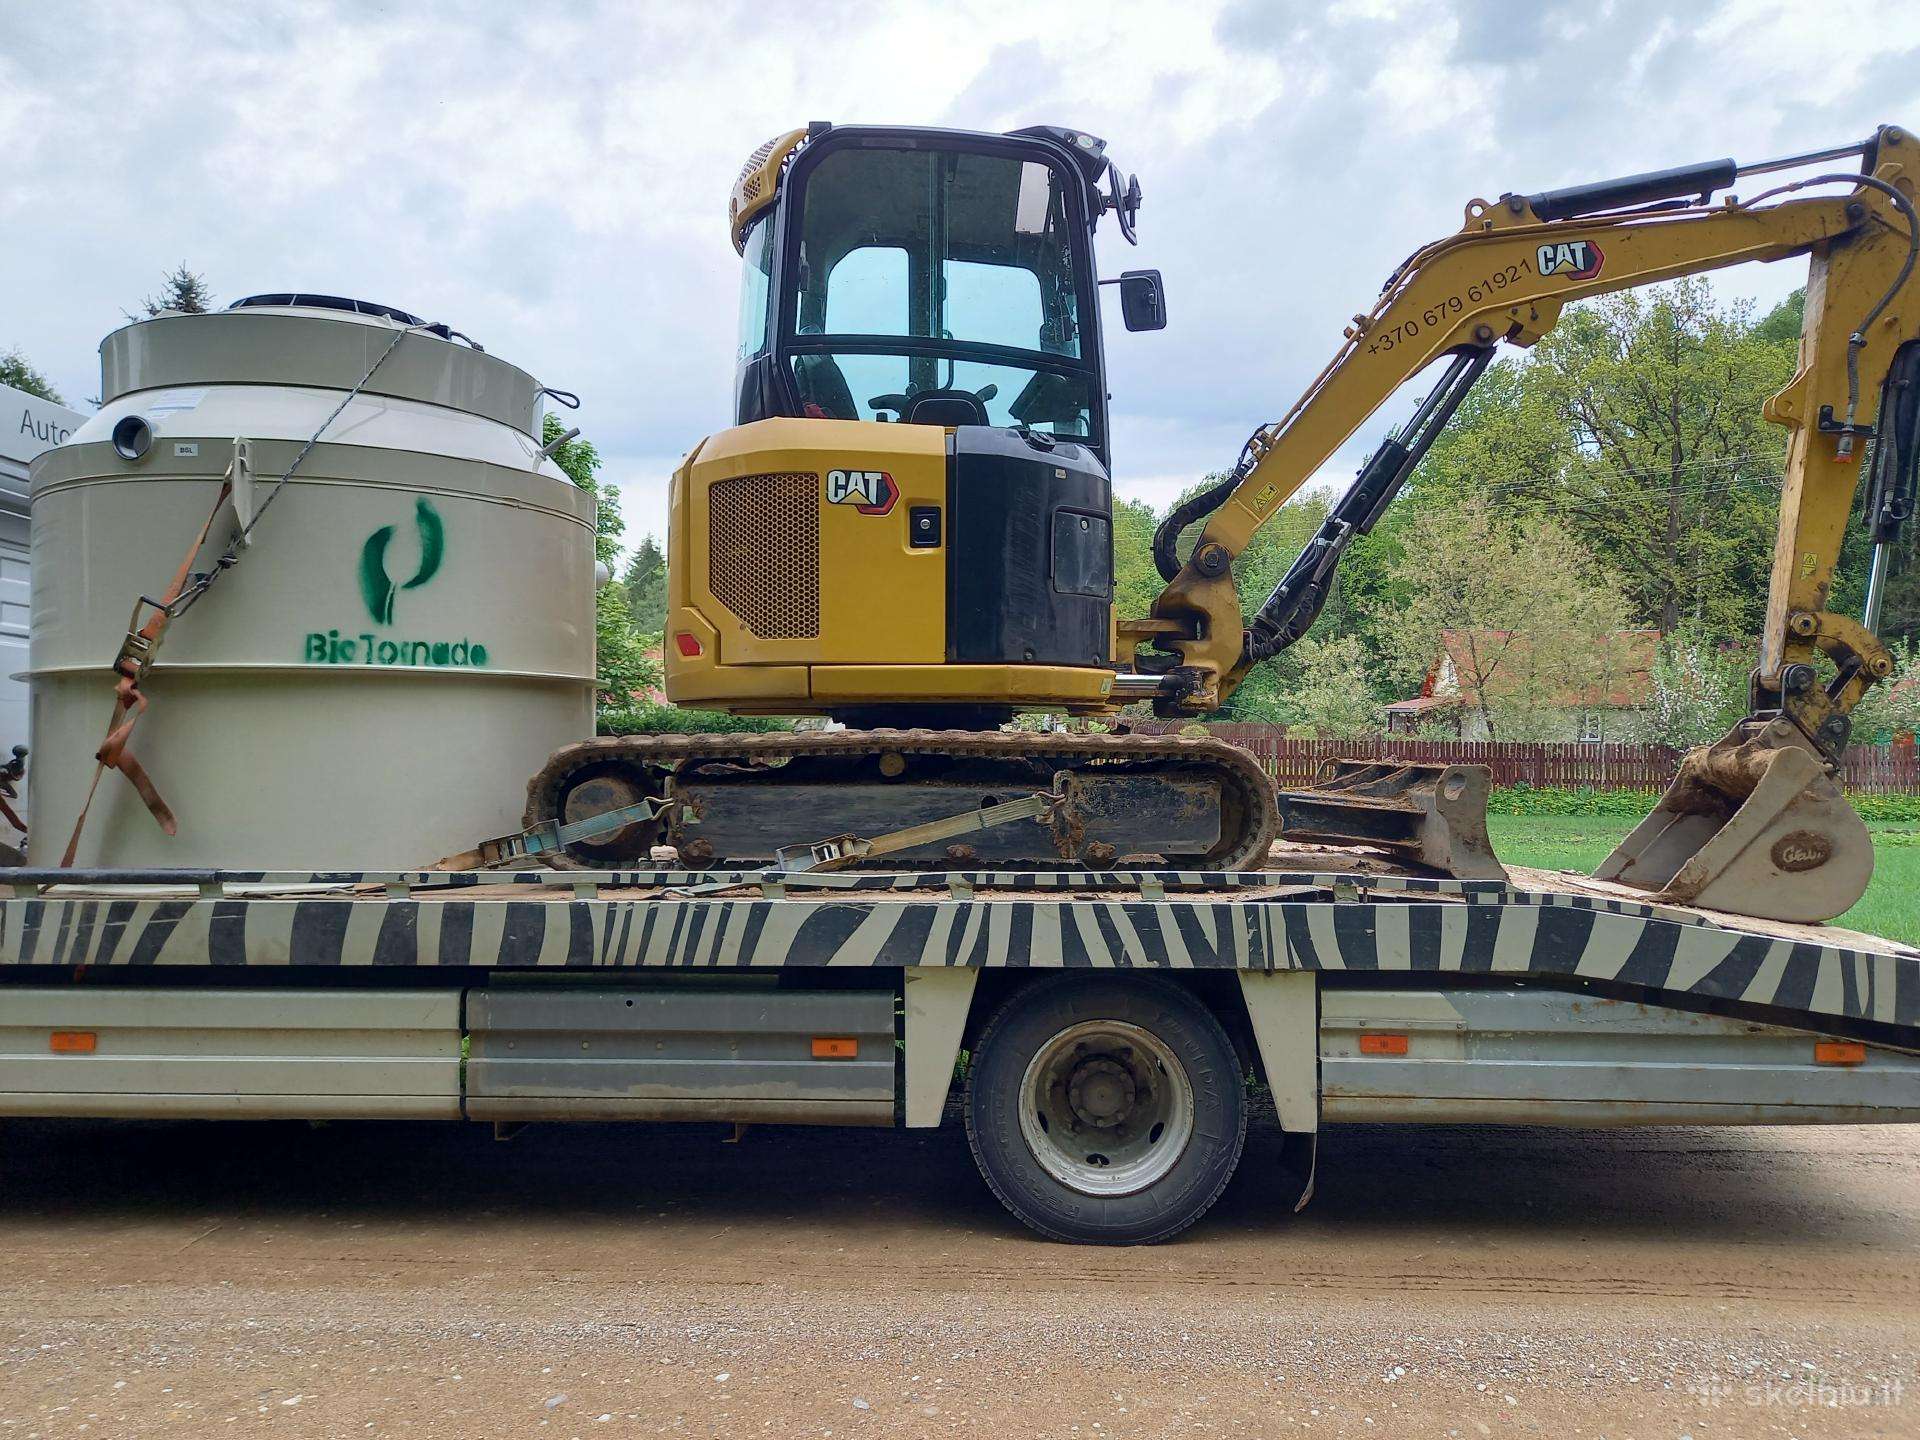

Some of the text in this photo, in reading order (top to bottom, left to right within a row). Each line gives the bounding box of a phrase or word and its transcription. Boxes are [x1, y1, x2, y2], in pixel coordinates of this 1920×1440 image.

[1538, 241, 1588, 277] CAT
[1368, 258, 1532, 355] +370 679 61921
[20, 409, 76, 445] Auto
[827, 470, 882, 505] CAT
